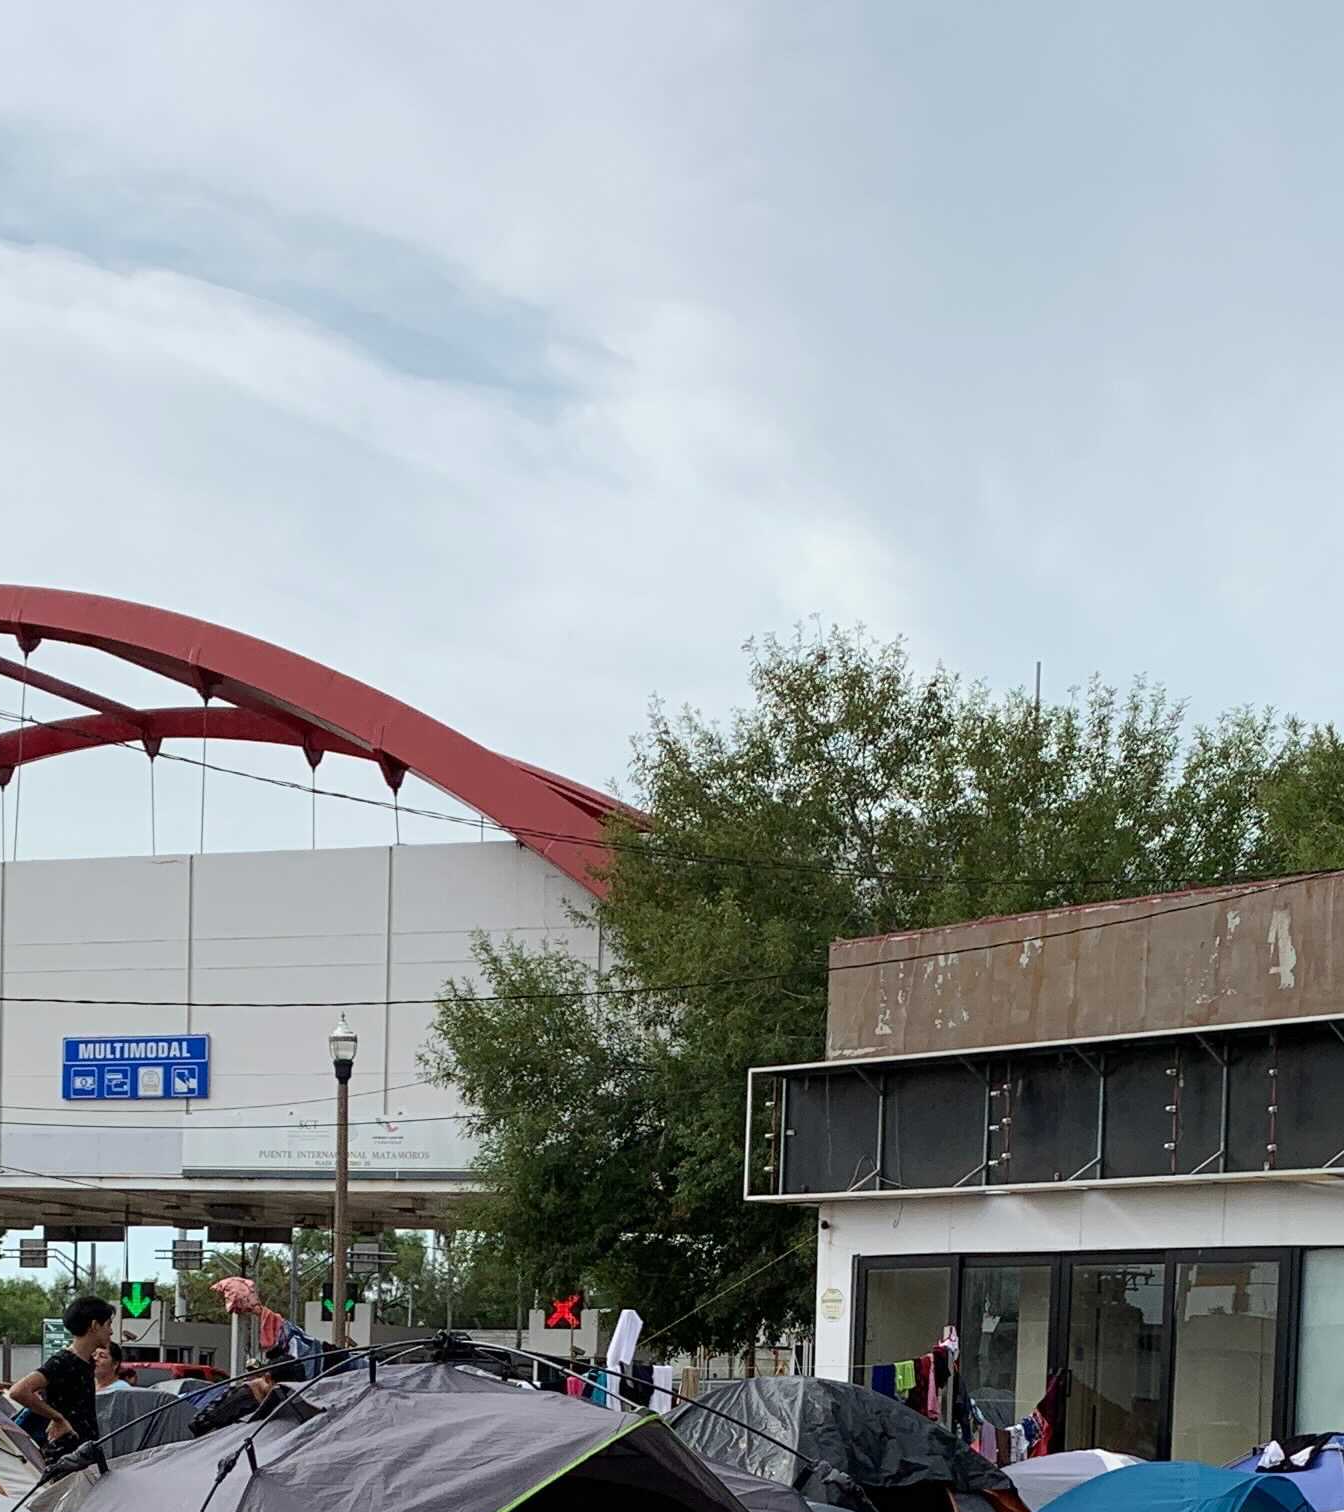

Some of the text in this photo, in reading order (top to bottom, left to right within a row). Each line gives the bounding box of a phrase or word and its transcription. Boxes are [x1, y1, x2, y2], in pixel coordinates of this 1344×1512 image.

[79, 1041, 191, 1060] MULTIMODAL
[259, 1151, 430, 1160] PUENTE INTERNANAL MATAMOROS
